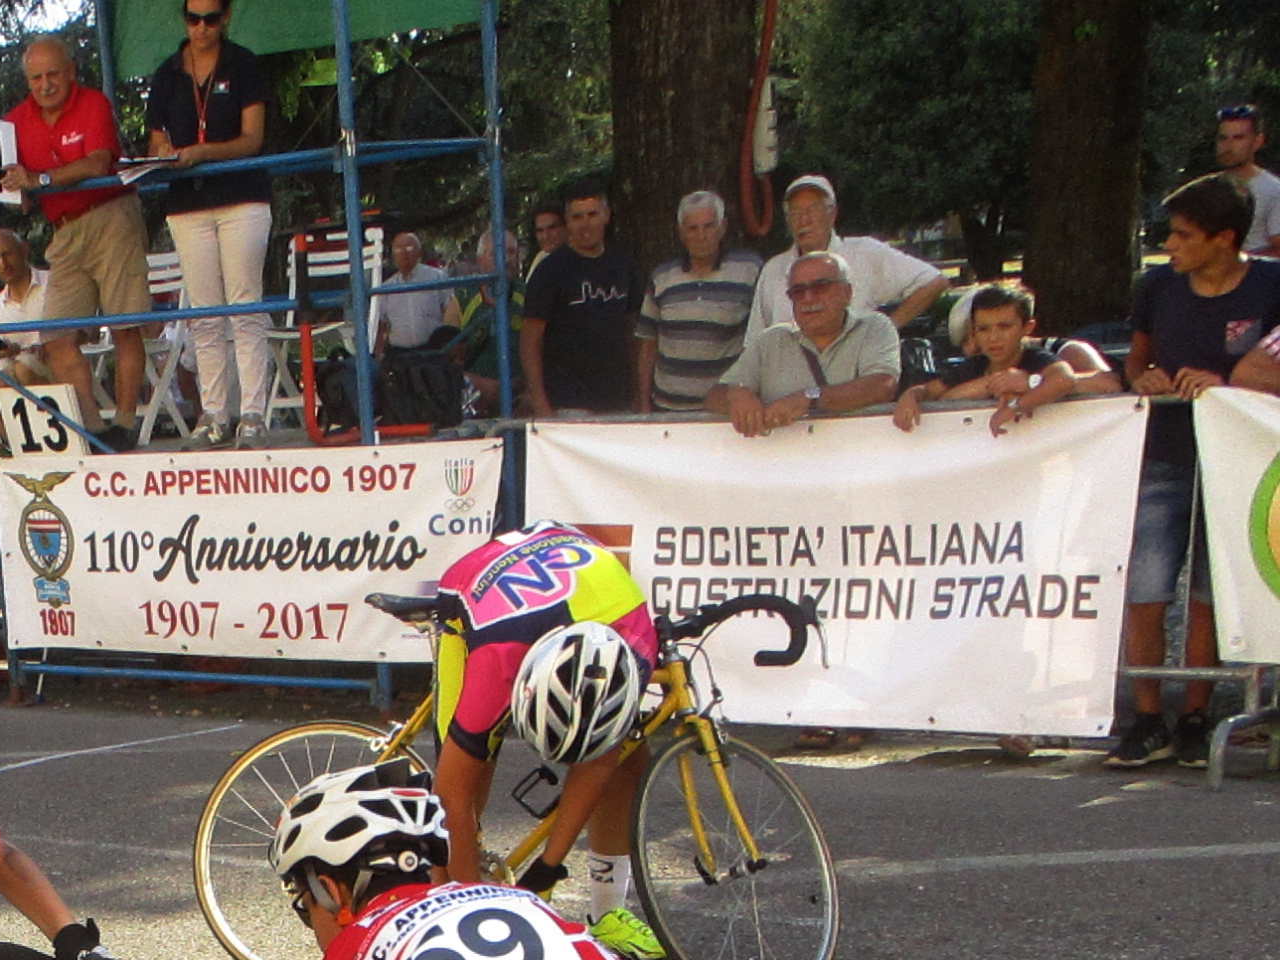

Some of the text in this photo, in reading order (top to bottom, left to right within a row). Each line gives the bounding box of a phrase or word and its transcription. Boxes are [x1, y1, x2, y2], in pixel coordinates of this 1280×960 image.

[11, 395, 69, 452] 13
[83, 463, 417, 498] C.C. APPENNINICO 1907
[428, 510, 492, 536] Coni
[841, 521, 1024, 567] ITALIANA
[152, 513, 428, 585] Anniversario
[928, 575, 1101, 621] STRADE
[138, 600, 221, 641] 1907
[257, 601, 350, 643] 2017
